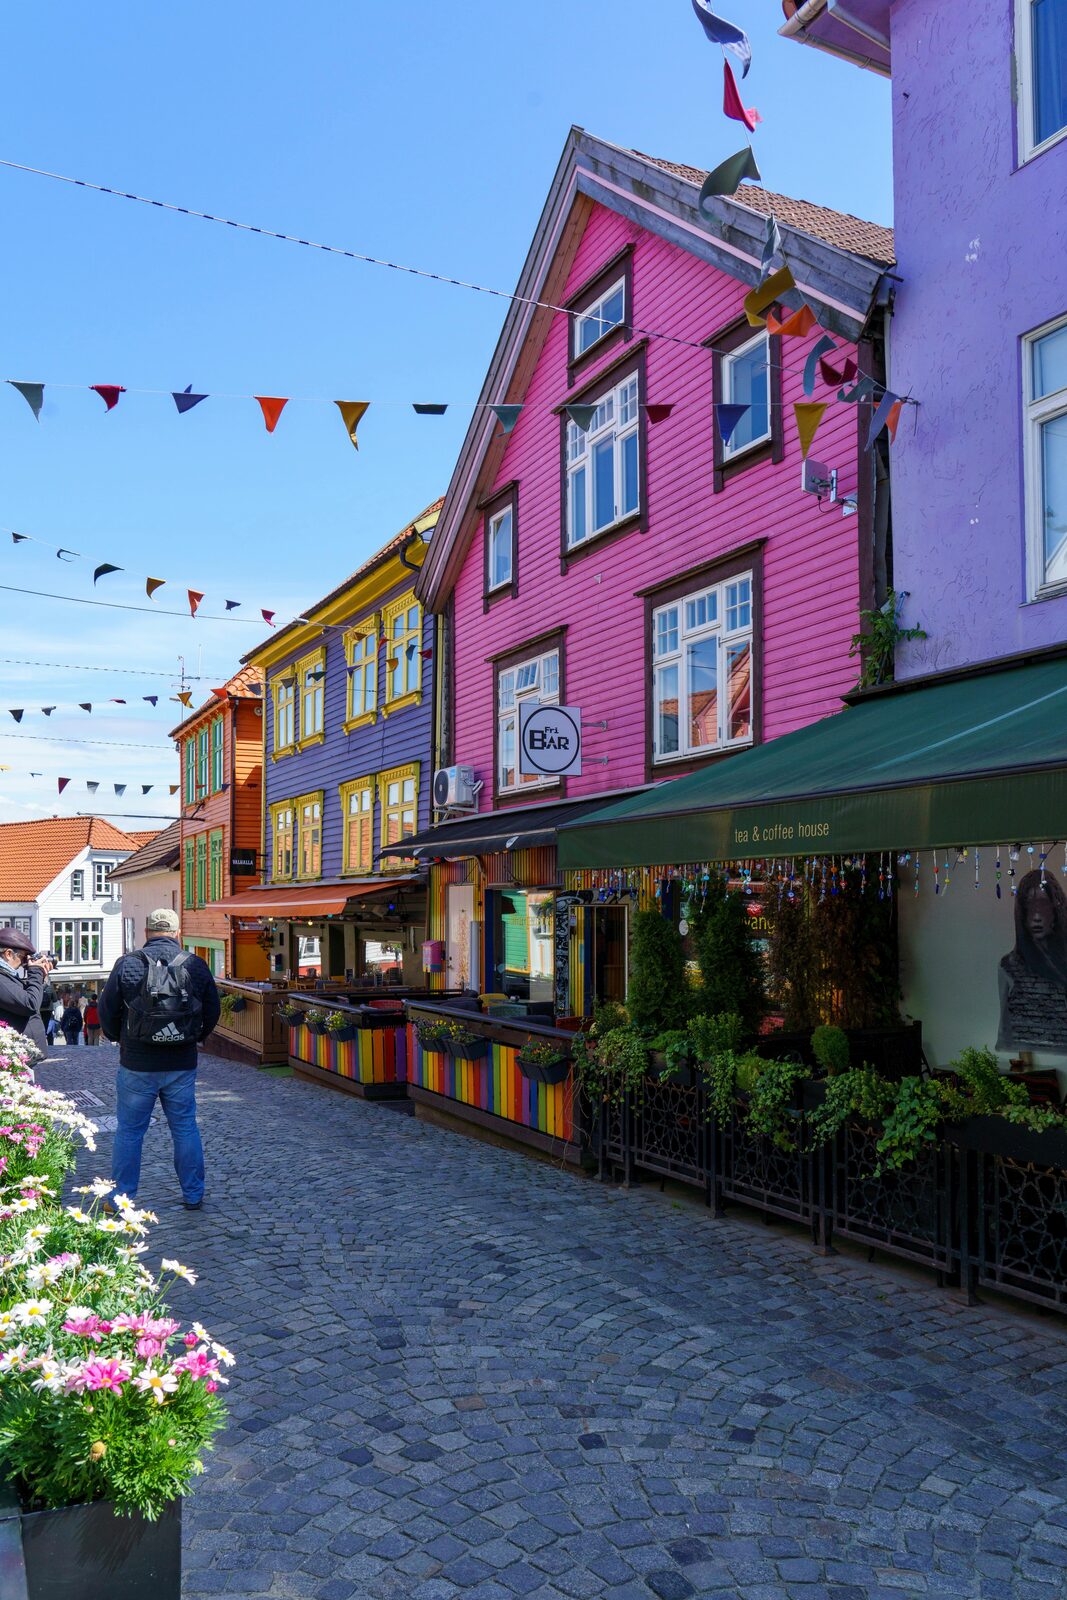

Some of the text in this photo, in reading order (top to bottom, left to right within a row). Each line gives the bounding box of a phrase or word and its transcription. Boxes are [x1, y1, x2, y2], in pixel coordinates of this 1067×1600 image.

[544, 726, 559, 734] Fri
[529, 730, 570, 750] BAR
[735, 822, 830, 843] tea & coffee house
[152, 1033, 185, 1042] adidas
